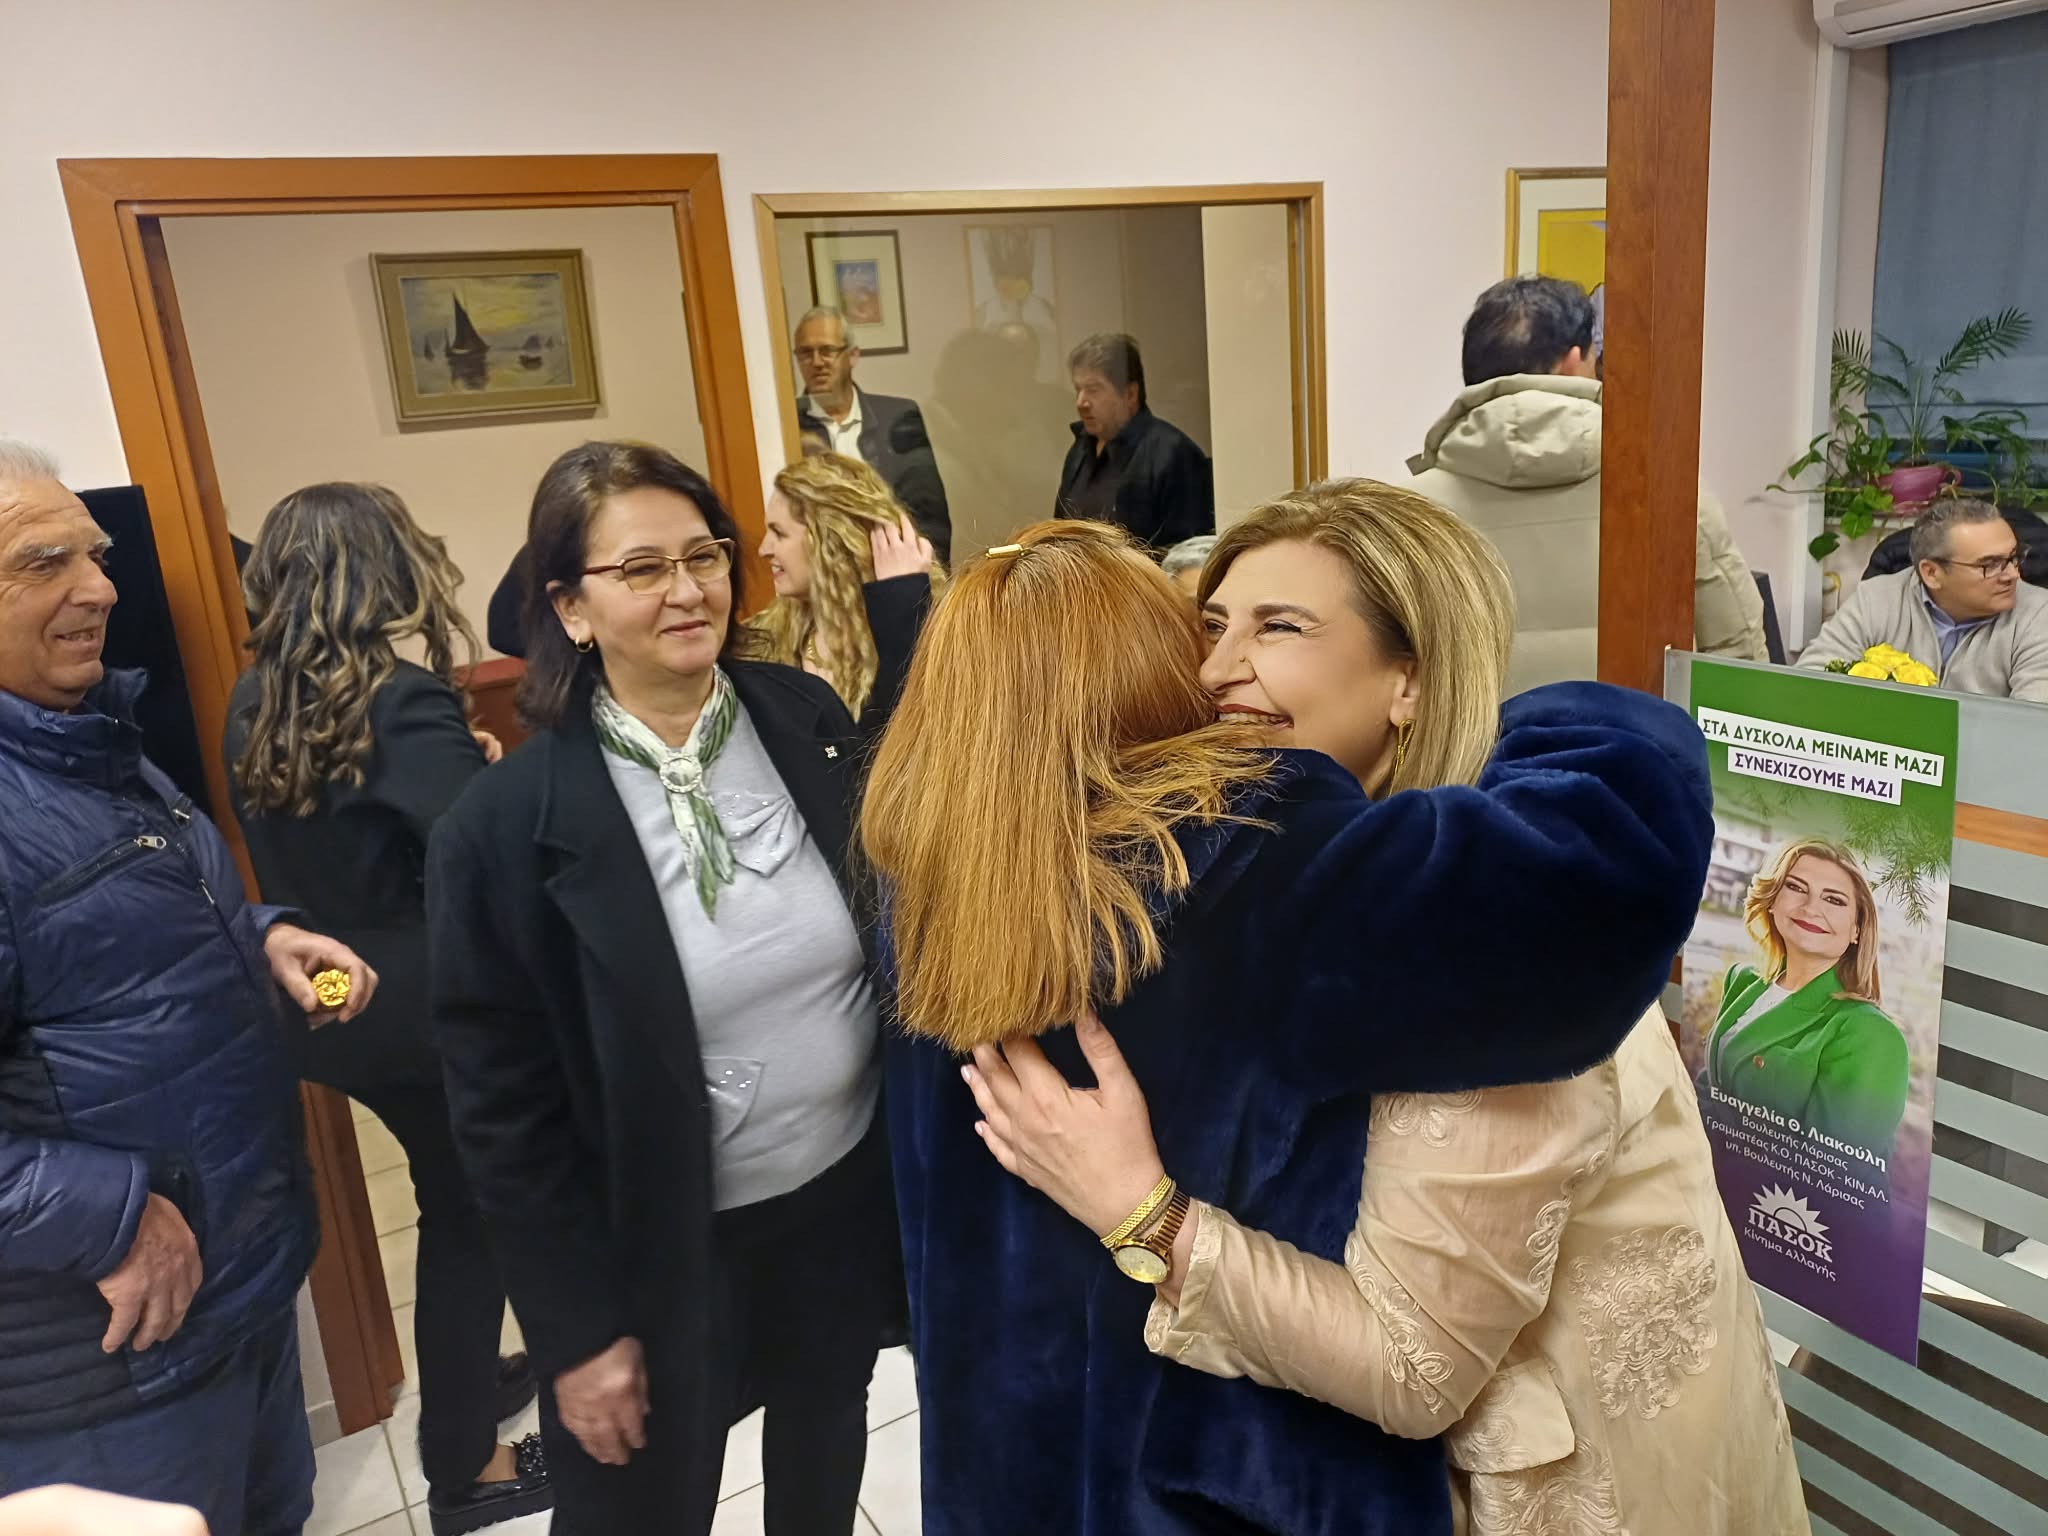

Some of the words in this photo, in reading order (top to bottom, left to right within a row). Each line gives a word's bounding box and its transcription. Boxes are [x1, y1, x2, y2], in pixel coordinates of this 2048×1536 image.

[1703, 719, 1728, 737] ΣΤΑ
[1734, 726, 1806, 752] ΔΥΣΚΟΛΑ
[1812, 740, 1888, 766] ΜΕΙΝΑΜΕ
[1894, 756, 1938, 776] ΜΑΖΙ
[1735, 753, 1846, 788] ΣΥΝΕΧΙΖΟΥΜΕ
[1852, 778, 1893, 798] ΜΑΖΙ
[1710, 1087, 1784, 1126] Ευαγγελία
[1788, 1118, 1804, 1135] Θ.
[1808, 1127, 1886, 1172] Λιακούλη
[1742, 1116, 1799, 1148] Βουλευτής
[1801, 1142, 1848, 1171] Λάρισας
[1706, 1116, 1769, 1151] Γραμματέας
[1771, 1143, 1792, 1160] Κ.Ο.
[1794, 1154, 1835, 1179] ΠΑΣΟΚ
[1844, 1176, 1889, 1202] ΚΙΝ.ΑΛ.
[1726, 1141, 1741, 1155] υπ.
[1744, 1147, 1800, 1180] Βουλευτής
[1802, 1173, 1813, 1186] Ν.
[1817, 1181, 1865, 1210] Λάρισας
[1748, 1207, 1833, 1263] ΠΑΣΟΚ
